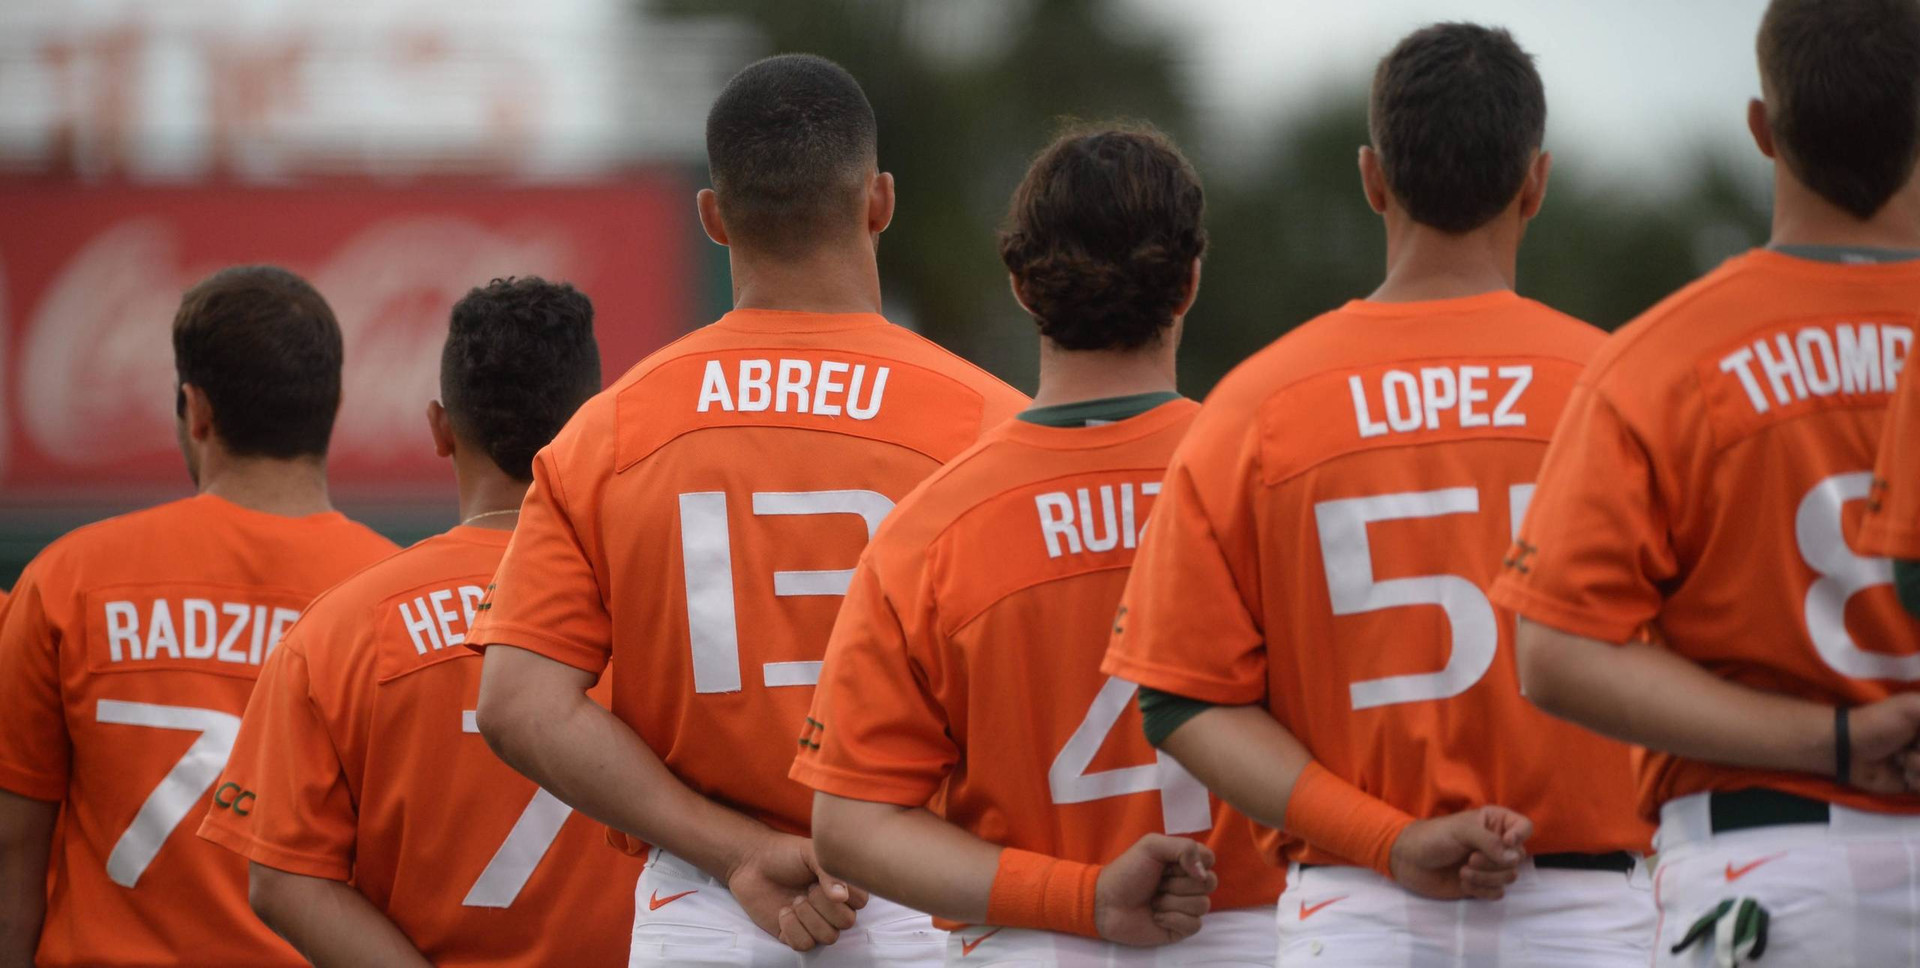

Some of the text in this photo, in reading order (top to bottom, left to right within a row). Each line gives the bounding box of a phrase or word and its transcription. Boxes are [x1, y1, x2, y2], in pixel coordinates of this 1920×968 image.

[697, 359, 889, 420] ABREU
[1349, 364, 1532, 438] LOPEZ
[679, 489, 897, 694] 13
[97, 700, 242, 889] 7
[1049, 678, 1212, 836] 4
